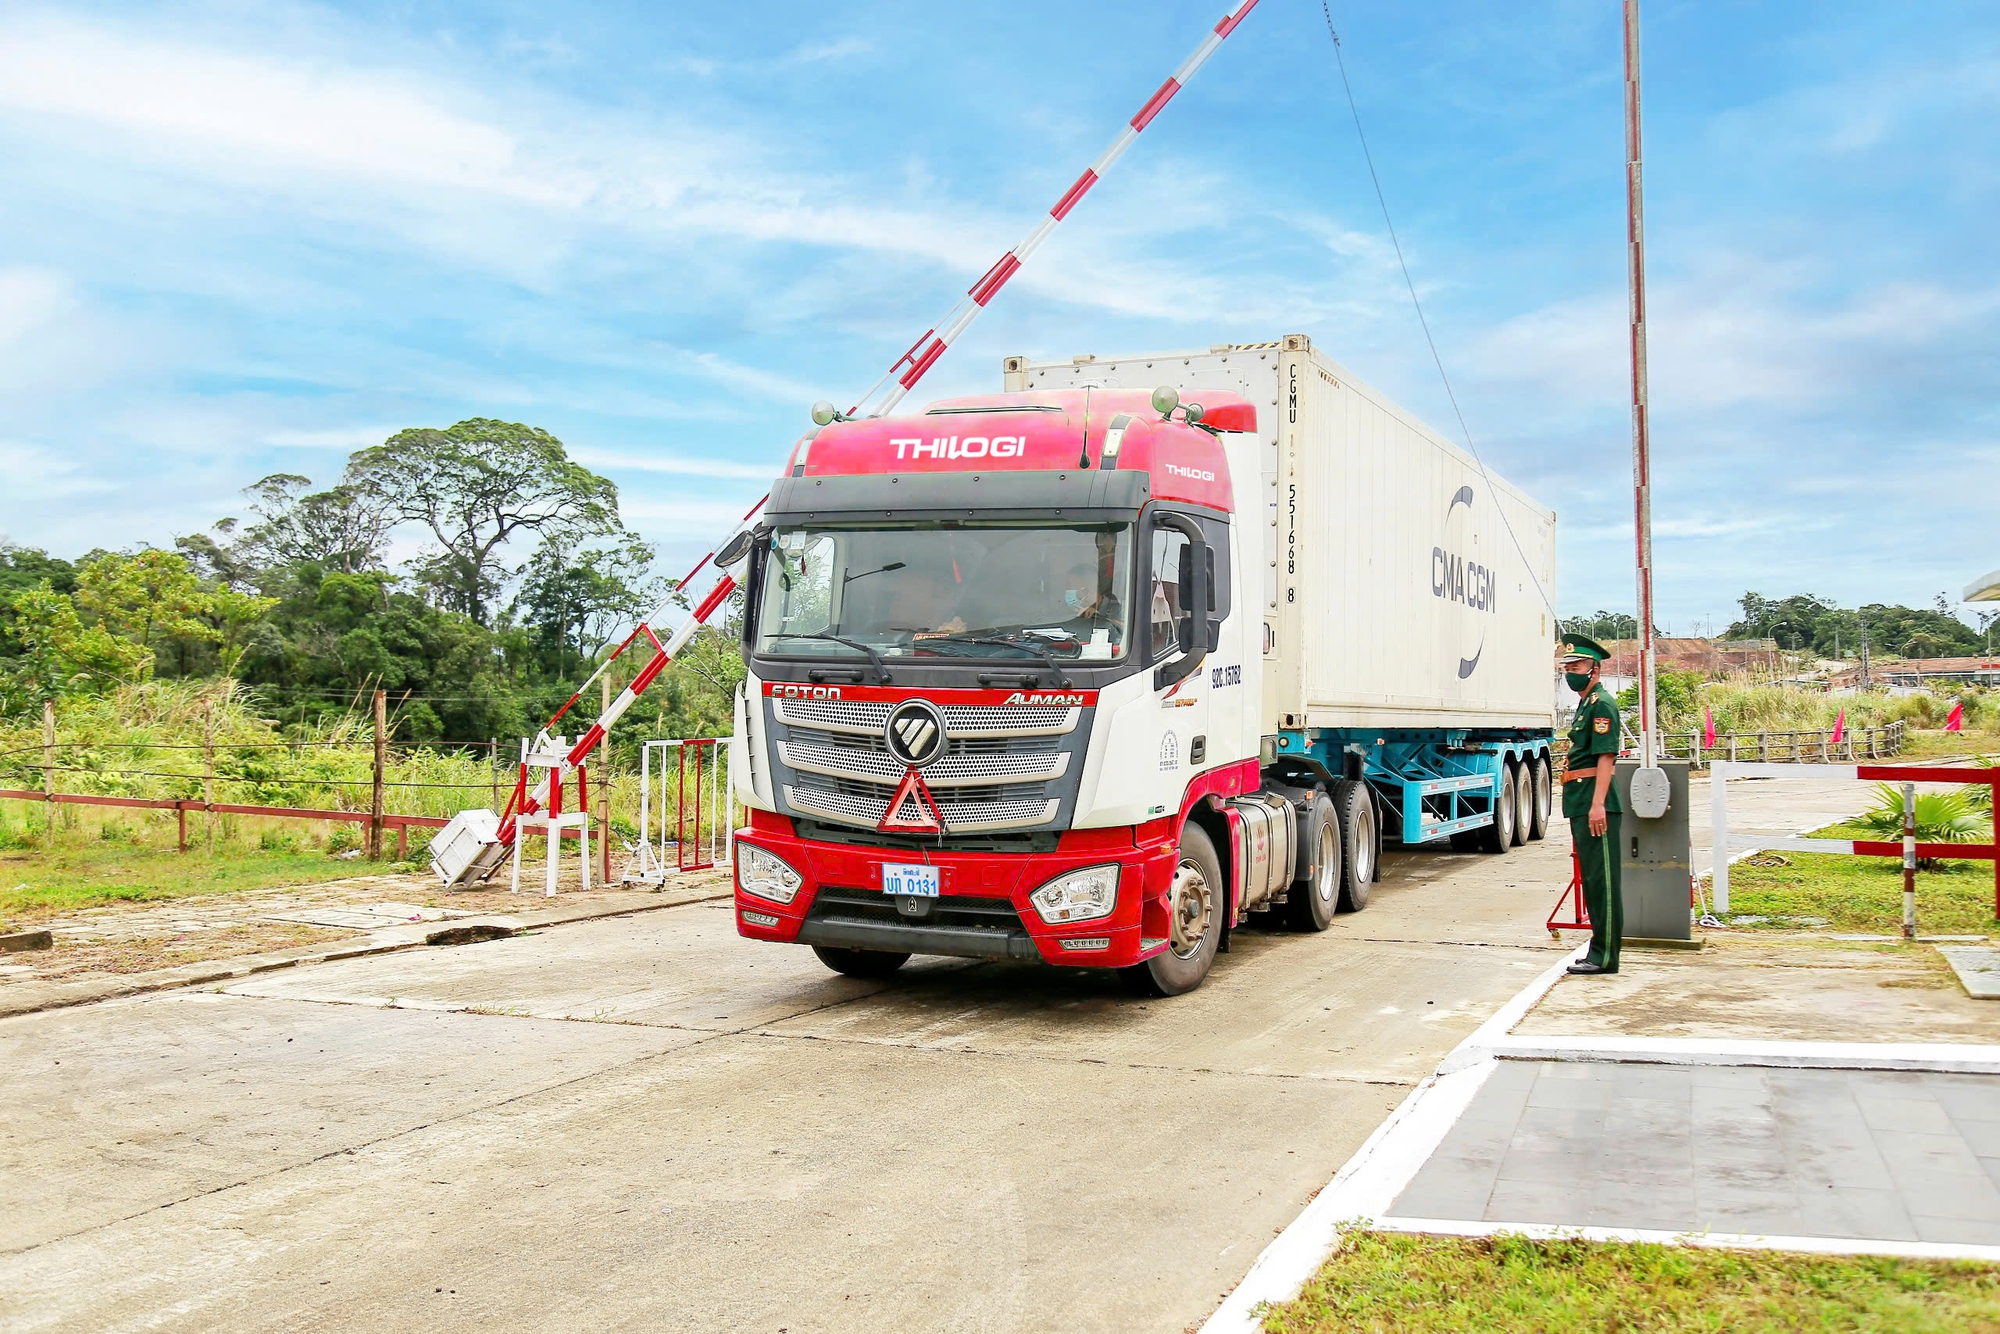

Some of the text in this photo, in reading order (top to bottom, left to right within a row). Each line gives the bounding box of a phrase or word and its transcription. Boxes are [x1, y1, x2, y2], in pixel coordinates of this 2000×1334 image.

[889, 436, 1026, 460] THILOGI
[1165, 463, 1215, 482] THILOGI
[1287, 363, 1297, 603] CGMU 551668 8
[1432, 546, 1496, 614] CMA CGM
[1212, 664, 1241, 690] 92C.15762
[772, 685, 841, 700] FOTON
[1003, 692, 1084, 705] AUMAN
[907, 878, 937, 894] 0131
